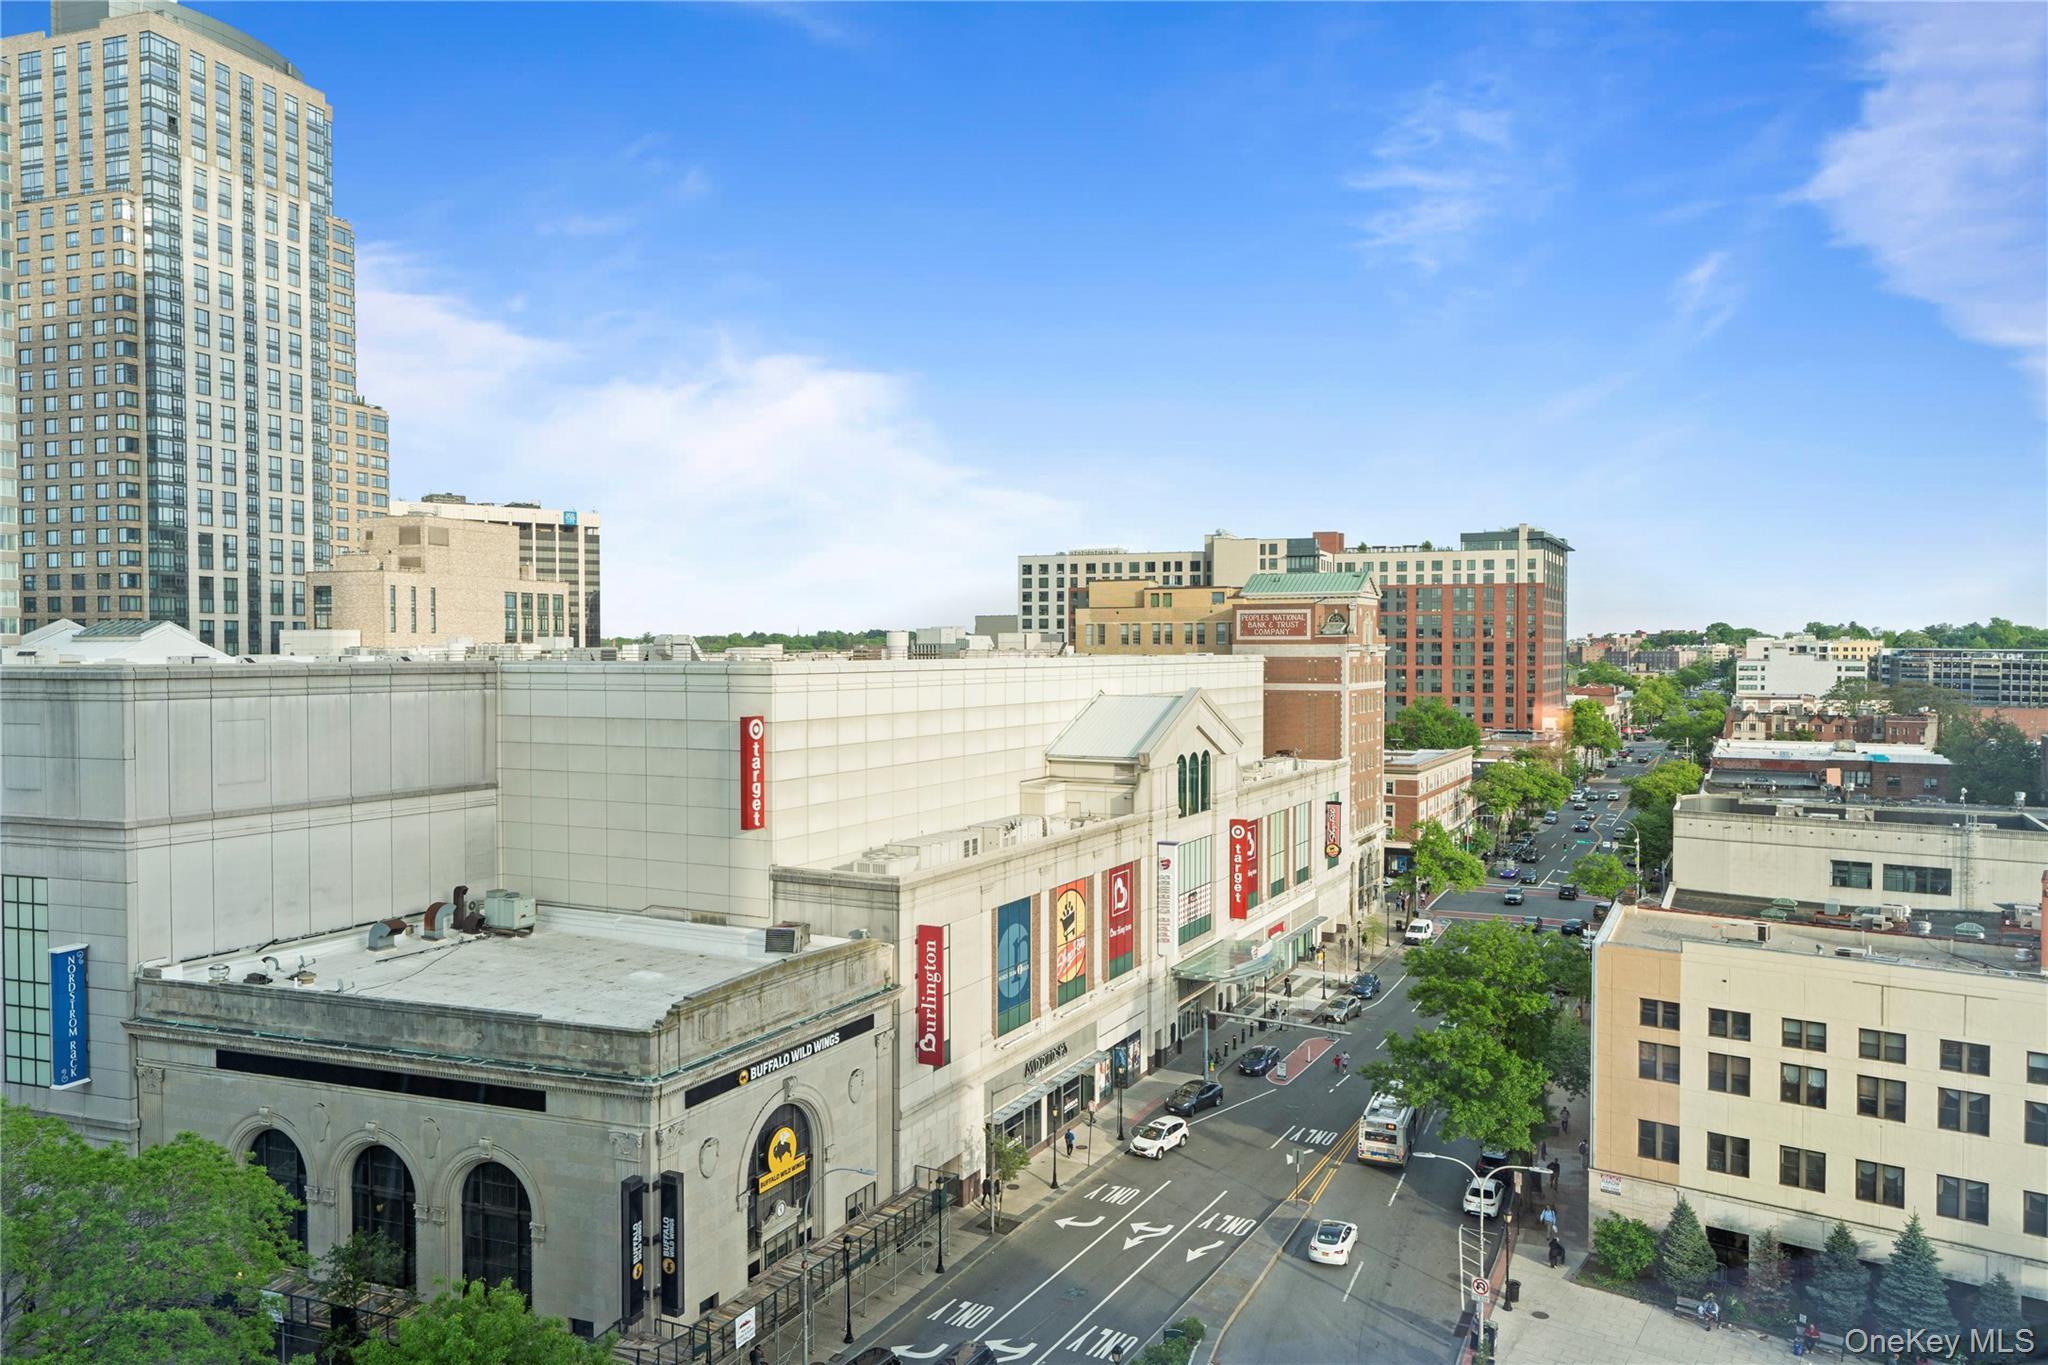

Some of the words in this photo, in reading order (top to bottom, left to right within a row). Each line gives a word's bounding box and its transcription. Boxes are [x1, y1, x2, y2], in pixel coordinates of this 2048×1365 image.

[752, 742, 761, 827] target
[1233, 843, 1242, 902] target
[67, 956, 78, 1037] NORDSTROM
[919, 940, 942, 1053] Burlington
[750, 1054, 790, 1081] BUFFALO
[791, 1043, 812, 1062] WILD
[813, 1032, 840, 1053] WINGS
[1289, 1127, 1338, 1146] ONLY
[760, 1173, 780, 1189] BUFFALO
[780, 1167, 791, 1178] WILD
[791, 1160, 805, 1173] WINGS
[1084, 1183, 1140, 1206] ONLY
[632, 1223, 640, 1264] BUFFALO
[1197, 1212, 1257, 1237] ONLY
[926, 1298, 995, 1329] ONLY
[1066, 1325, 1139, 1362] ONLY
